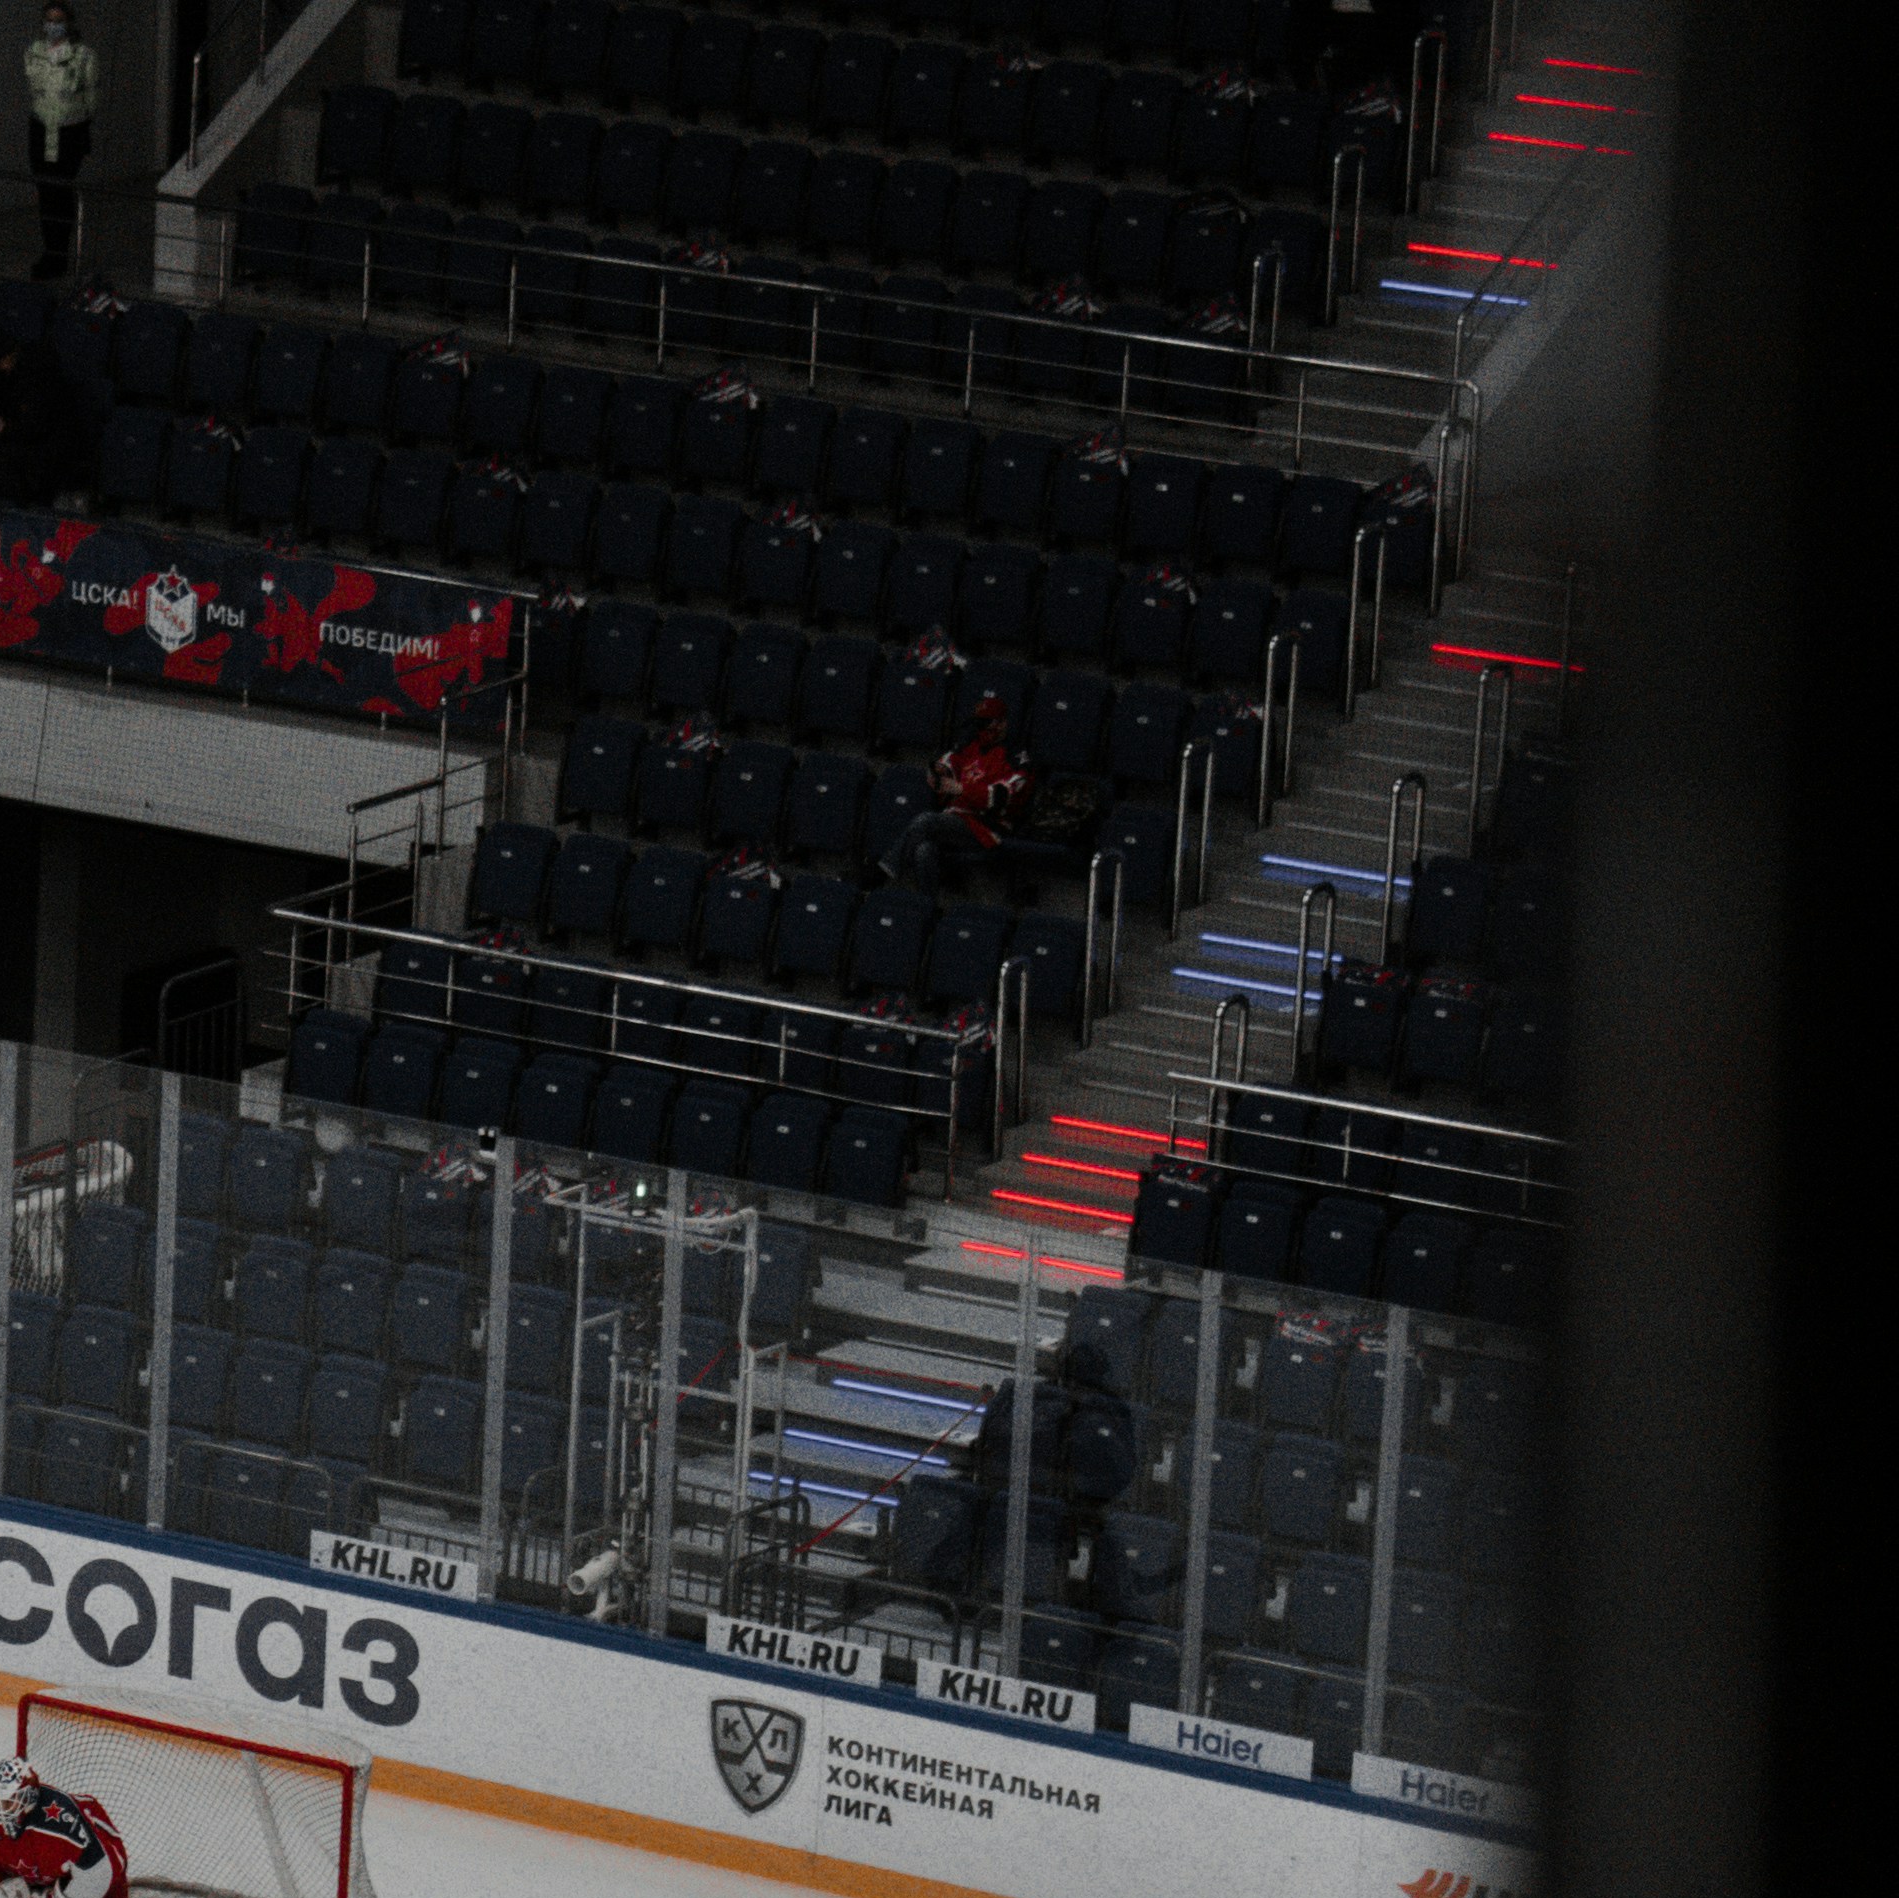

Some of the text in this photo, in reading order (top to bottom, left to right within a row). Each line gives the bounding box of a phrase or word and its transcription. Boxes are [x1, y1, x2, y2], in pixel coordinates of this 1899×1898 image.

[71, 578, 140, 611] ЦСКА!
[206, 602, 245, 629] МЫ
[319, 621, 440, 661] ПОБЕДИМ!
[329, 1540, 460, 1593] KHL.RU
[726, 1622, 861, 1678] KHL.RU
[937, 1668, 1074, 1723] KHL.RU
[1175, 1719, 1264, 1764] Haier
[826, 1764, 995, 1820] ХОККЕЙНАЯ
[828, 1735, 1101, 1815] КОНТИНЕНТАЛЬНАЯ
[1399, 1769, 1490, 1813] Haier
[824, 1794, 893, 1827] ЛИГА
